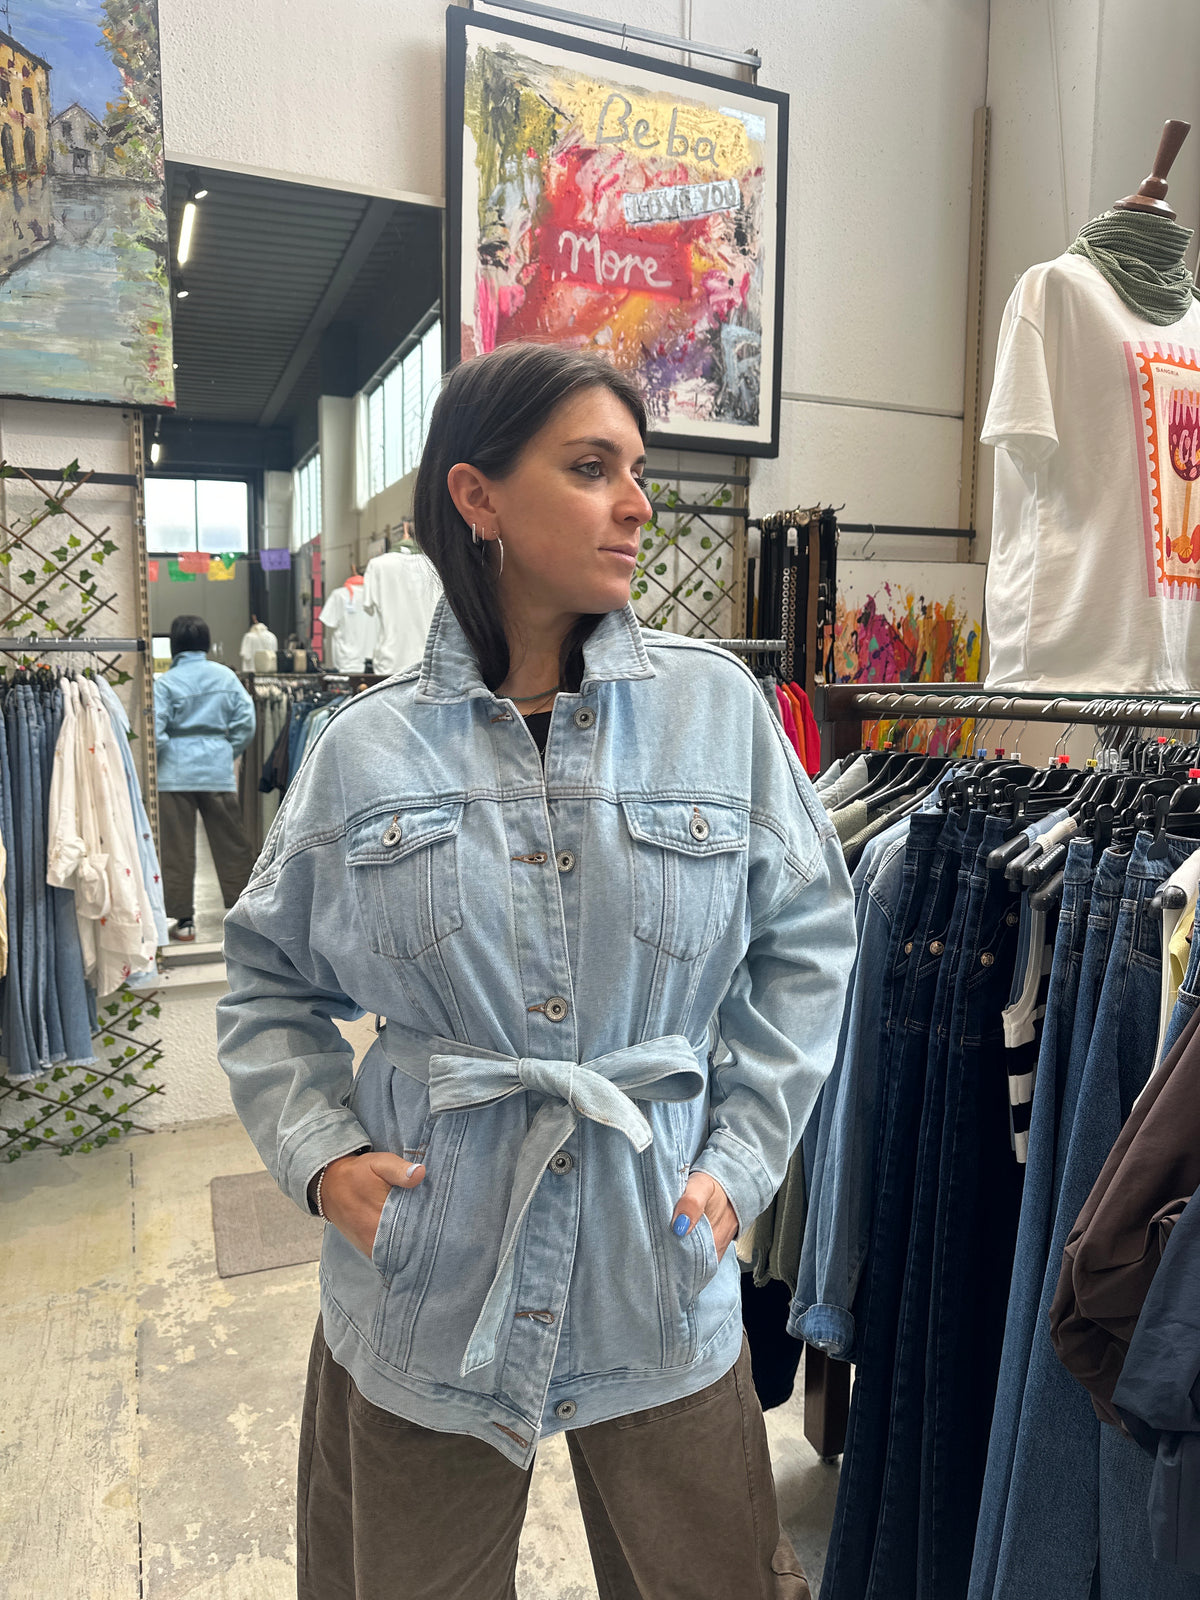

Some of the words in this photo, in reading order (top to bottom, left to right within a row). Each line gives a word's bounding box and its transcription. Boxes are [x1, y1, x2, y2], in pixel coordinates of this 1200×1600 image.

[699, 180, 736, 211] YOU
[558, 231, 673, 287] More
[1160, 385, 1200, 427] WIN
